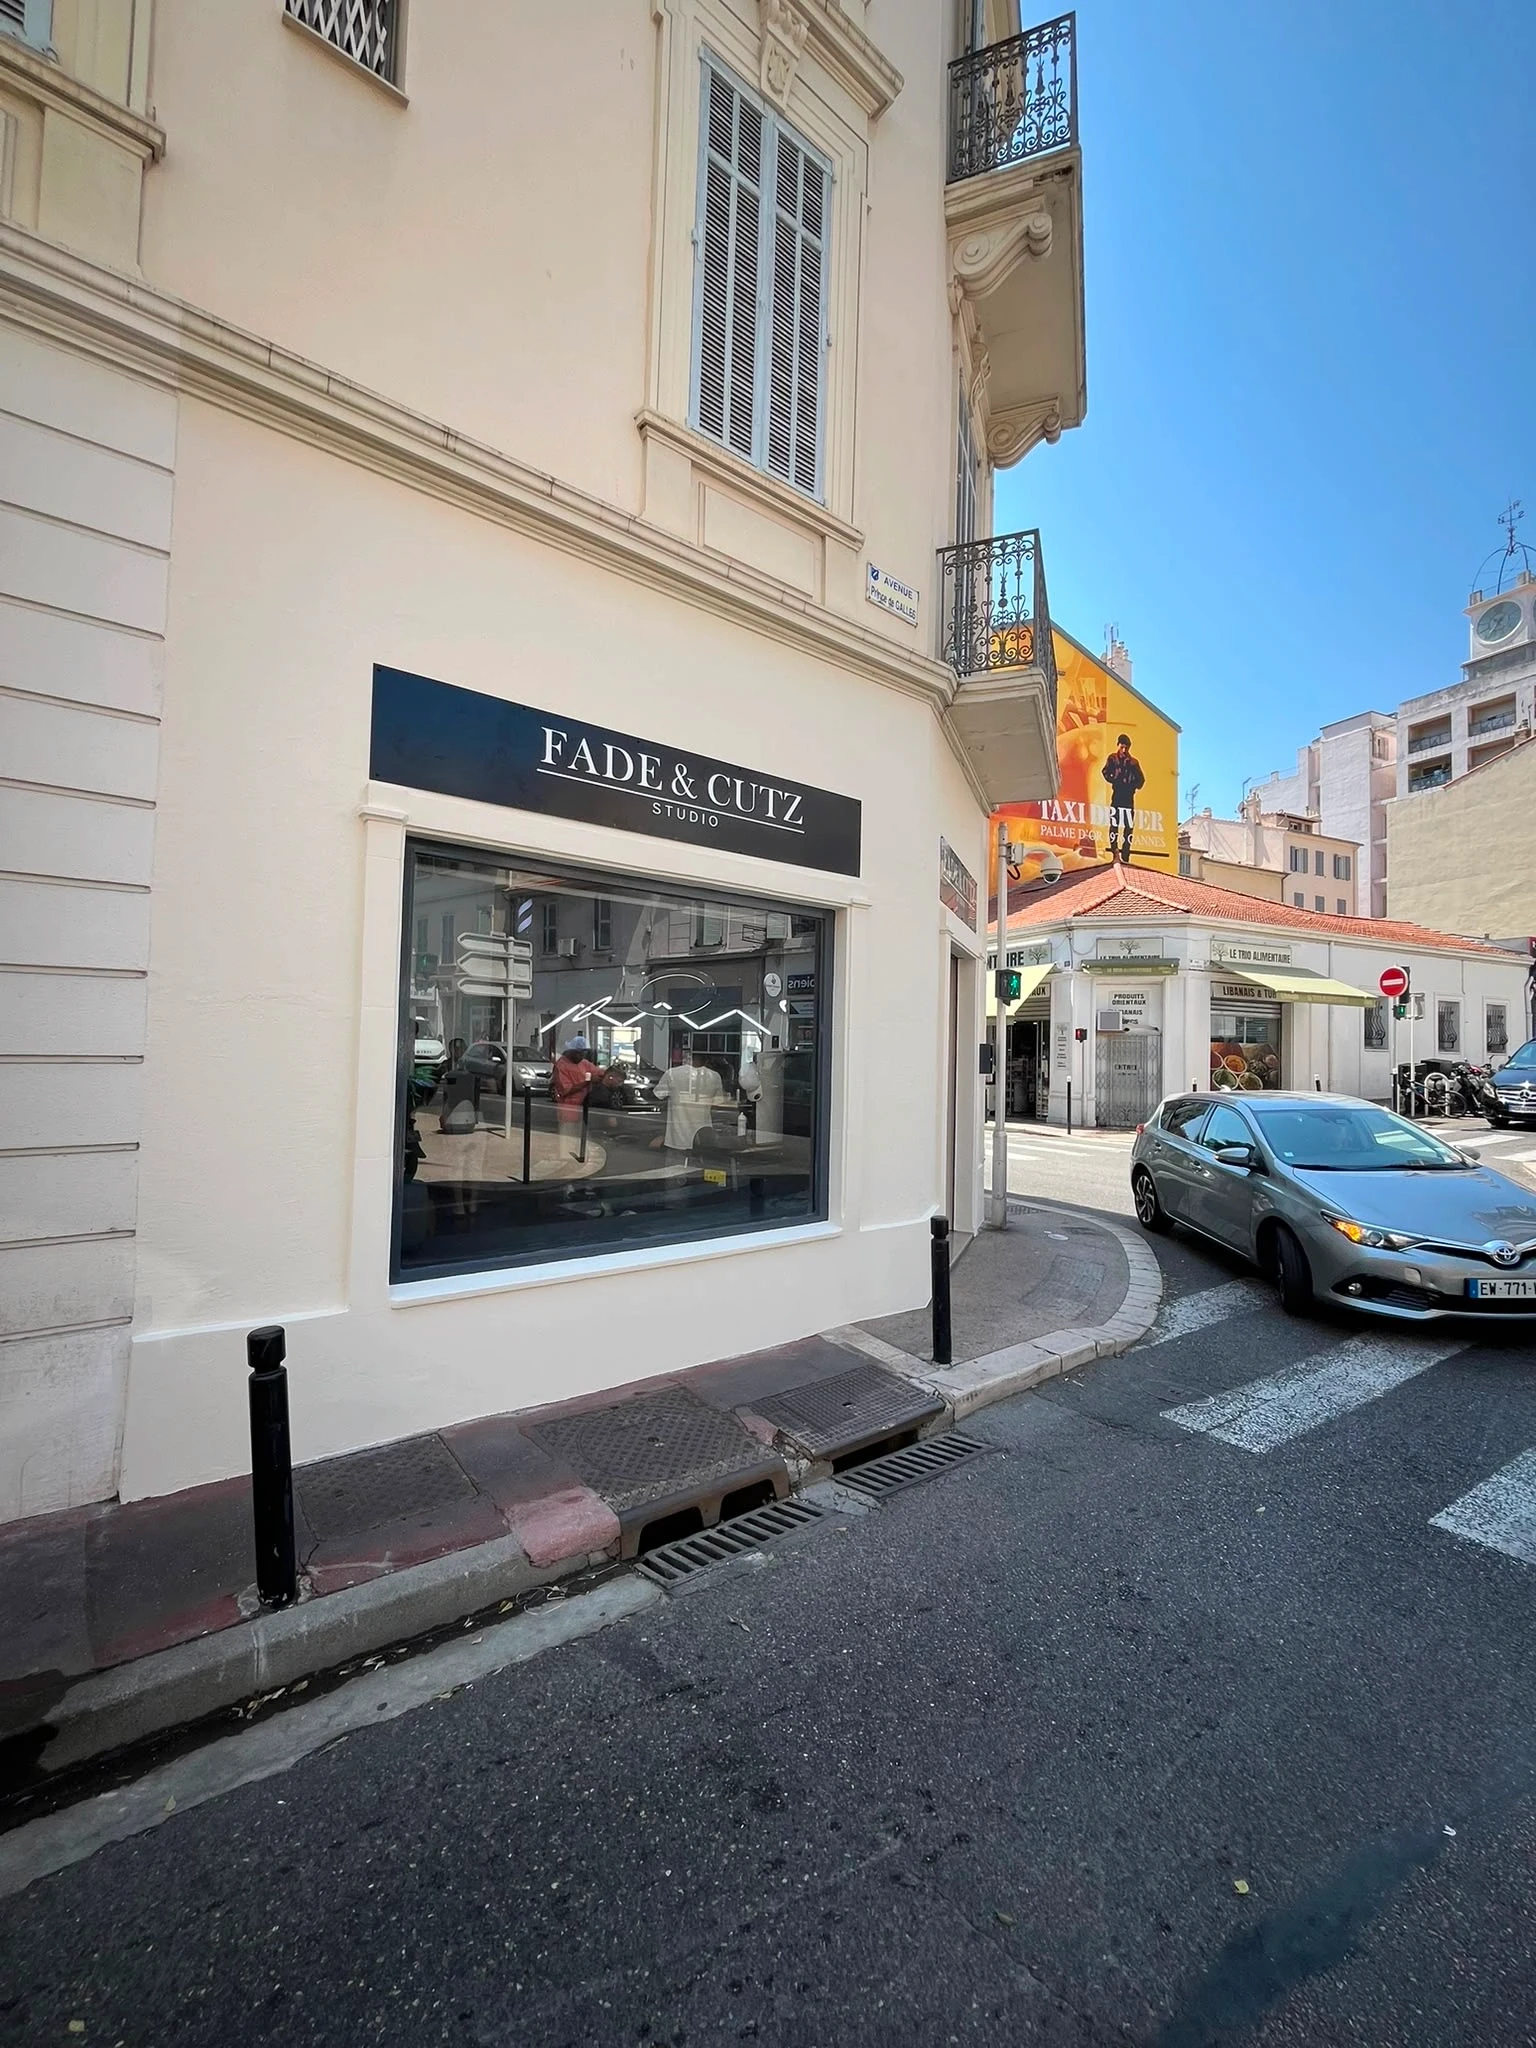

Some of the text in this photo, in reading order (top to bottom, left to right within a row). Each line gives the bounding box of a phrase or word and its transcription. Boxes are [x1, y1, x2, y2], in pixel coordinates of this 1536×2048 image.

[883, 576, 913, 600] AVENUE
[870, 585, 916, 620] Prince de GALLES
[541, 726, 804, 825] FADE & CUTZ
[652, 802, 719, 828] STUDIO
[1038, 799, 1164, 832] TAXI DRIVER
[1040, 824, 1076, 839] PALME
[1078, 828, 1103, 841] D'OR
[1127, 833, 1166, 848] CANNES
[1229, 948, 1291, 964] LE TRIO ALIMENTAIRE
[1222, 985, 1255, 998] LIBANAIS
